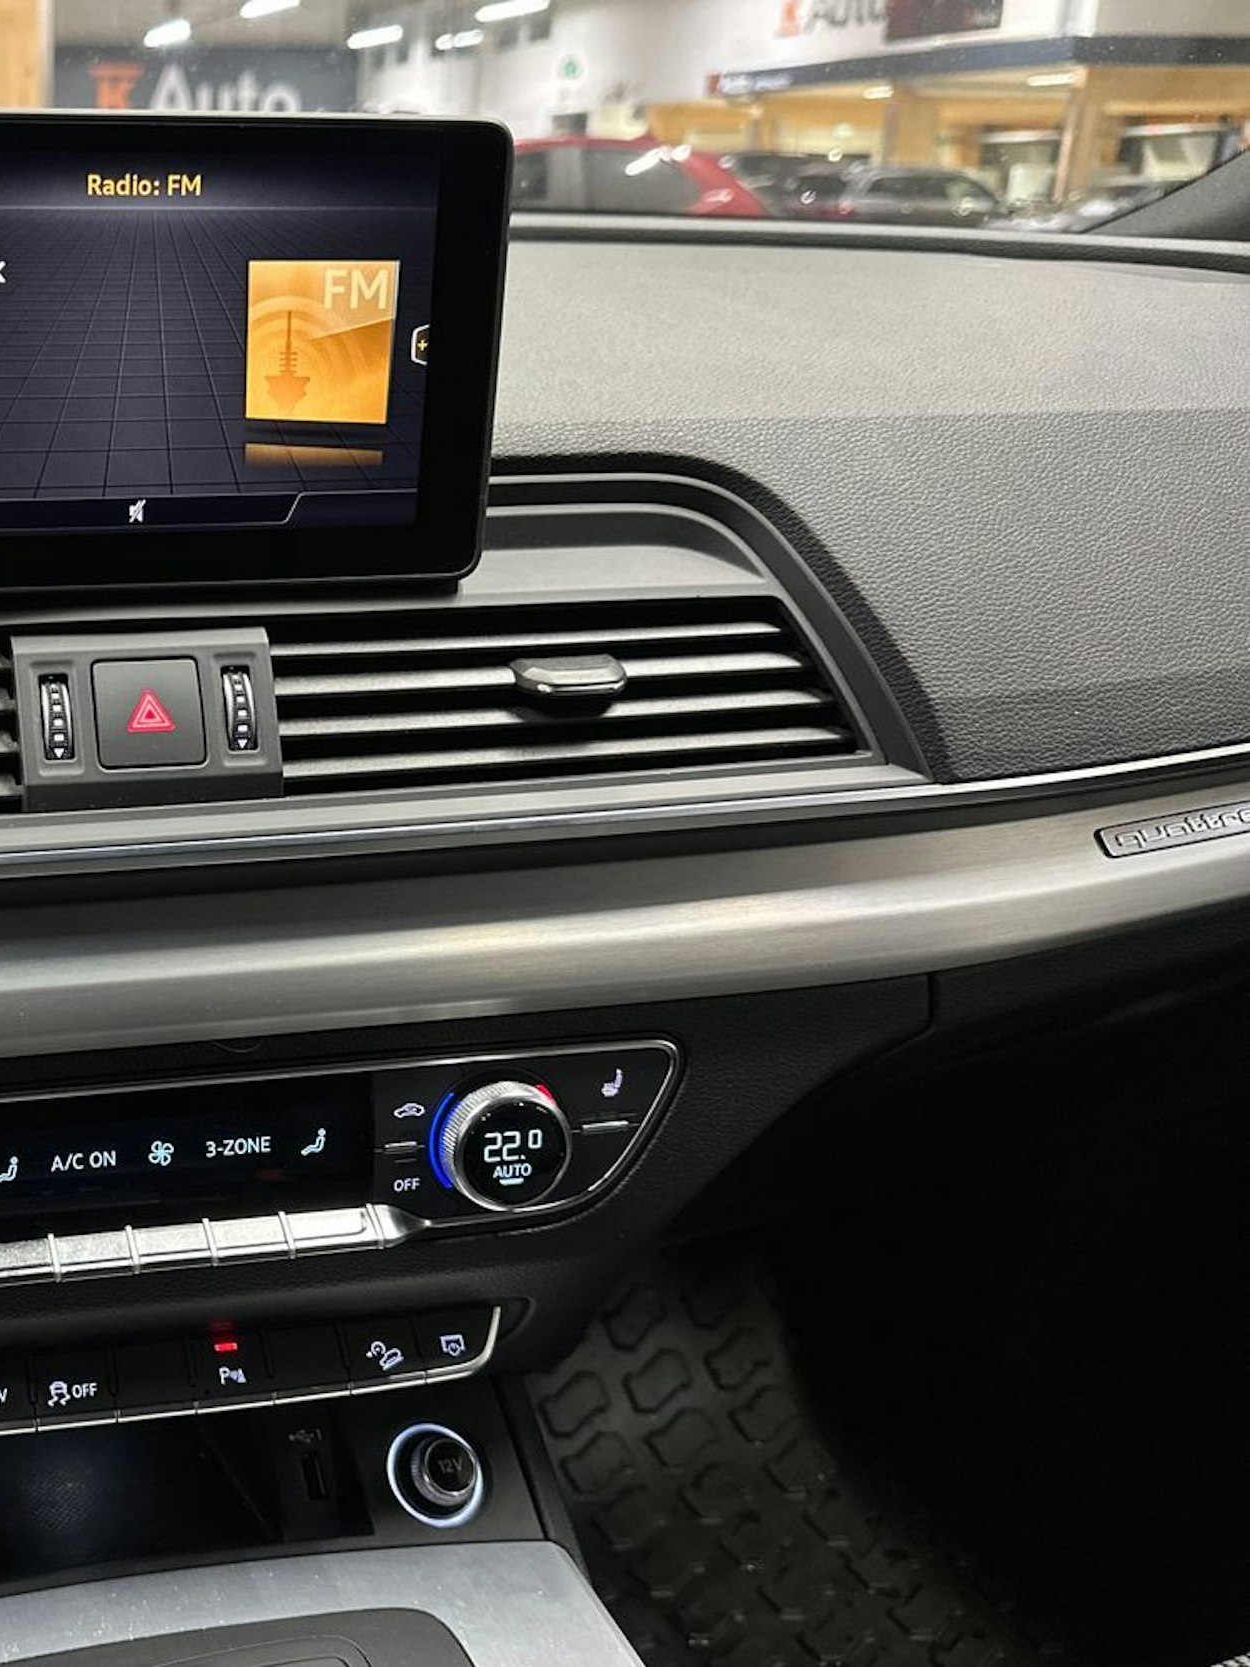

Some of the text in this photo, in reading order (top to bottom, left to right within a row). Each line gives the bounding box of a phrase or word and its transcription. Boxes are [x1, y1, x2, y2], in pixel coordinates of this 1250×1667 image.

[87, 174, 202, 196] Radio: FM
[323, 270, 388, 310] FM
[205, 1136, 272, 1158] 3-ZONE
[484, 1129, 543, 1162] 22.0
[50, 1150, 117, 1172] A/C ON
[493, 1163, 533, 1179] AUTO
[393, 1178, 421, 1192] OFF
[72, 1382, 98, 1399] OFF
